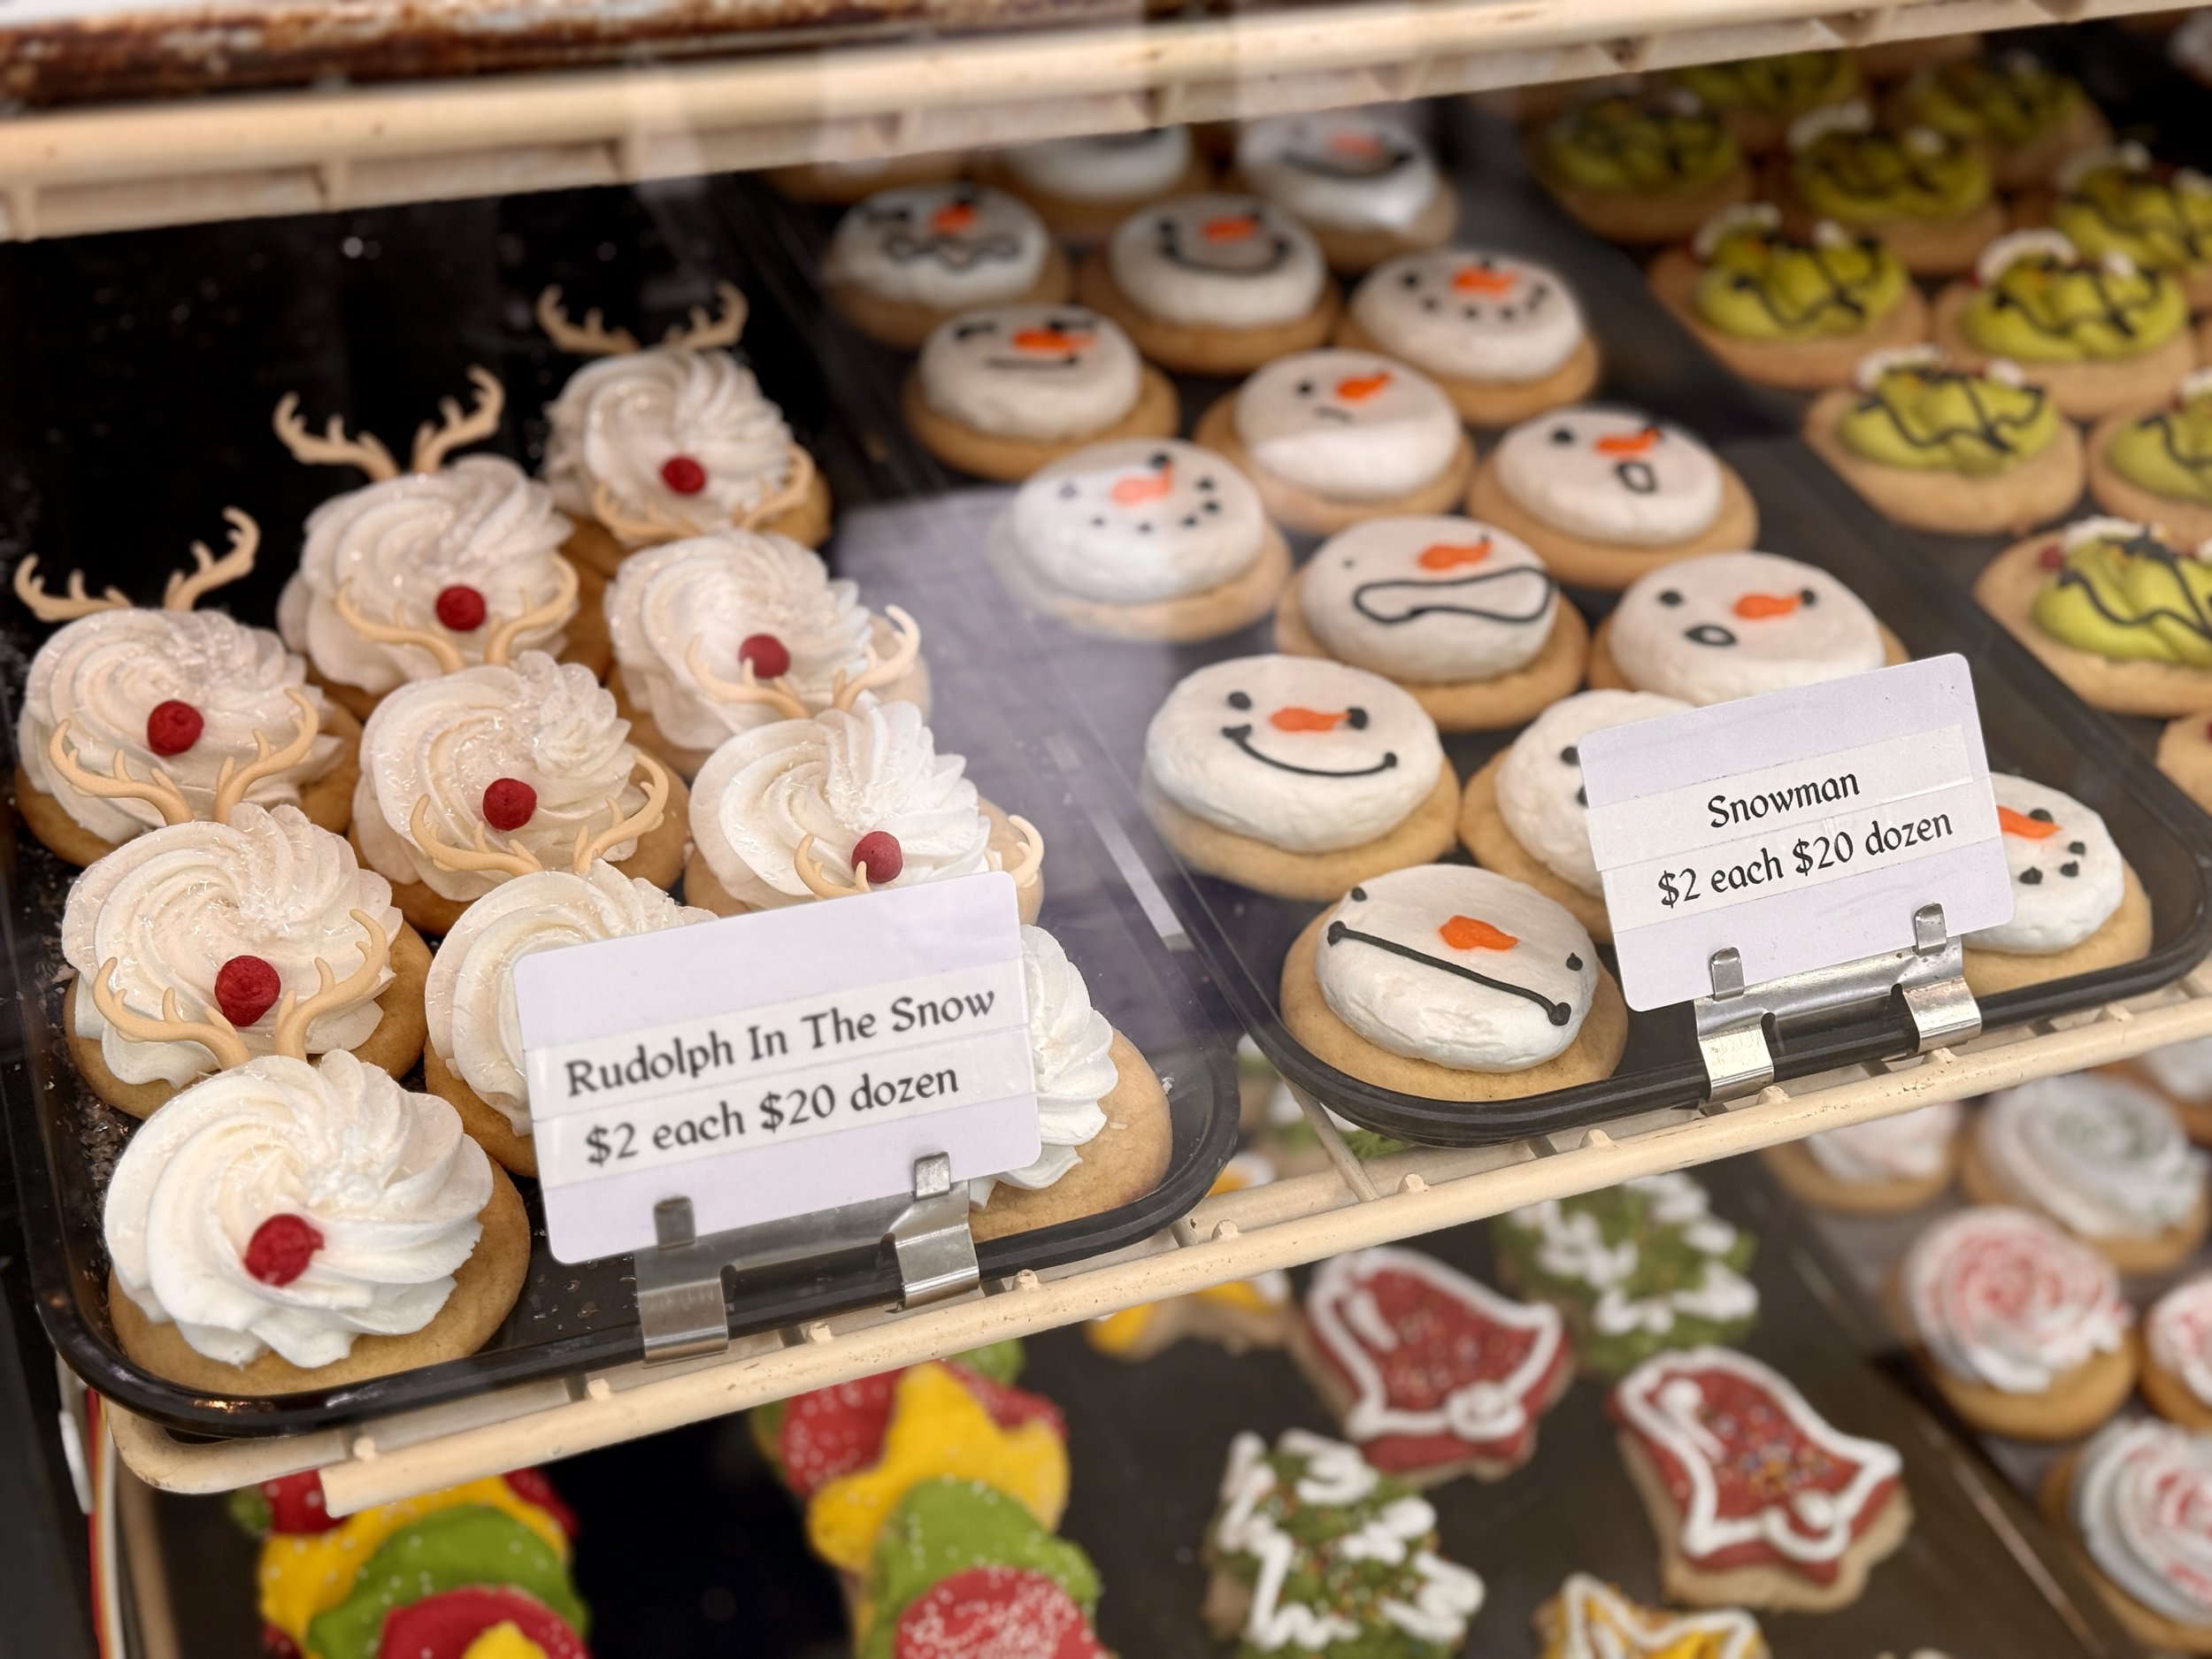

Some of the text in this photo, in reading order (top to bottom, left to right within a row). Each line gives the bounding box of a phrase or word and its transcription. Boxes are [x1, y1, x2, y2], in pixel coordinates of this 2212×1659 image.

[1708, 774, 1860, 827] Snowman
[1658, 814, 1953, 909] $2 each $20 dozen
[566, 992, 994, 1095] Rudolph In The Snow
[586, 1070, 958, 1166] $2 each $20 dozen
